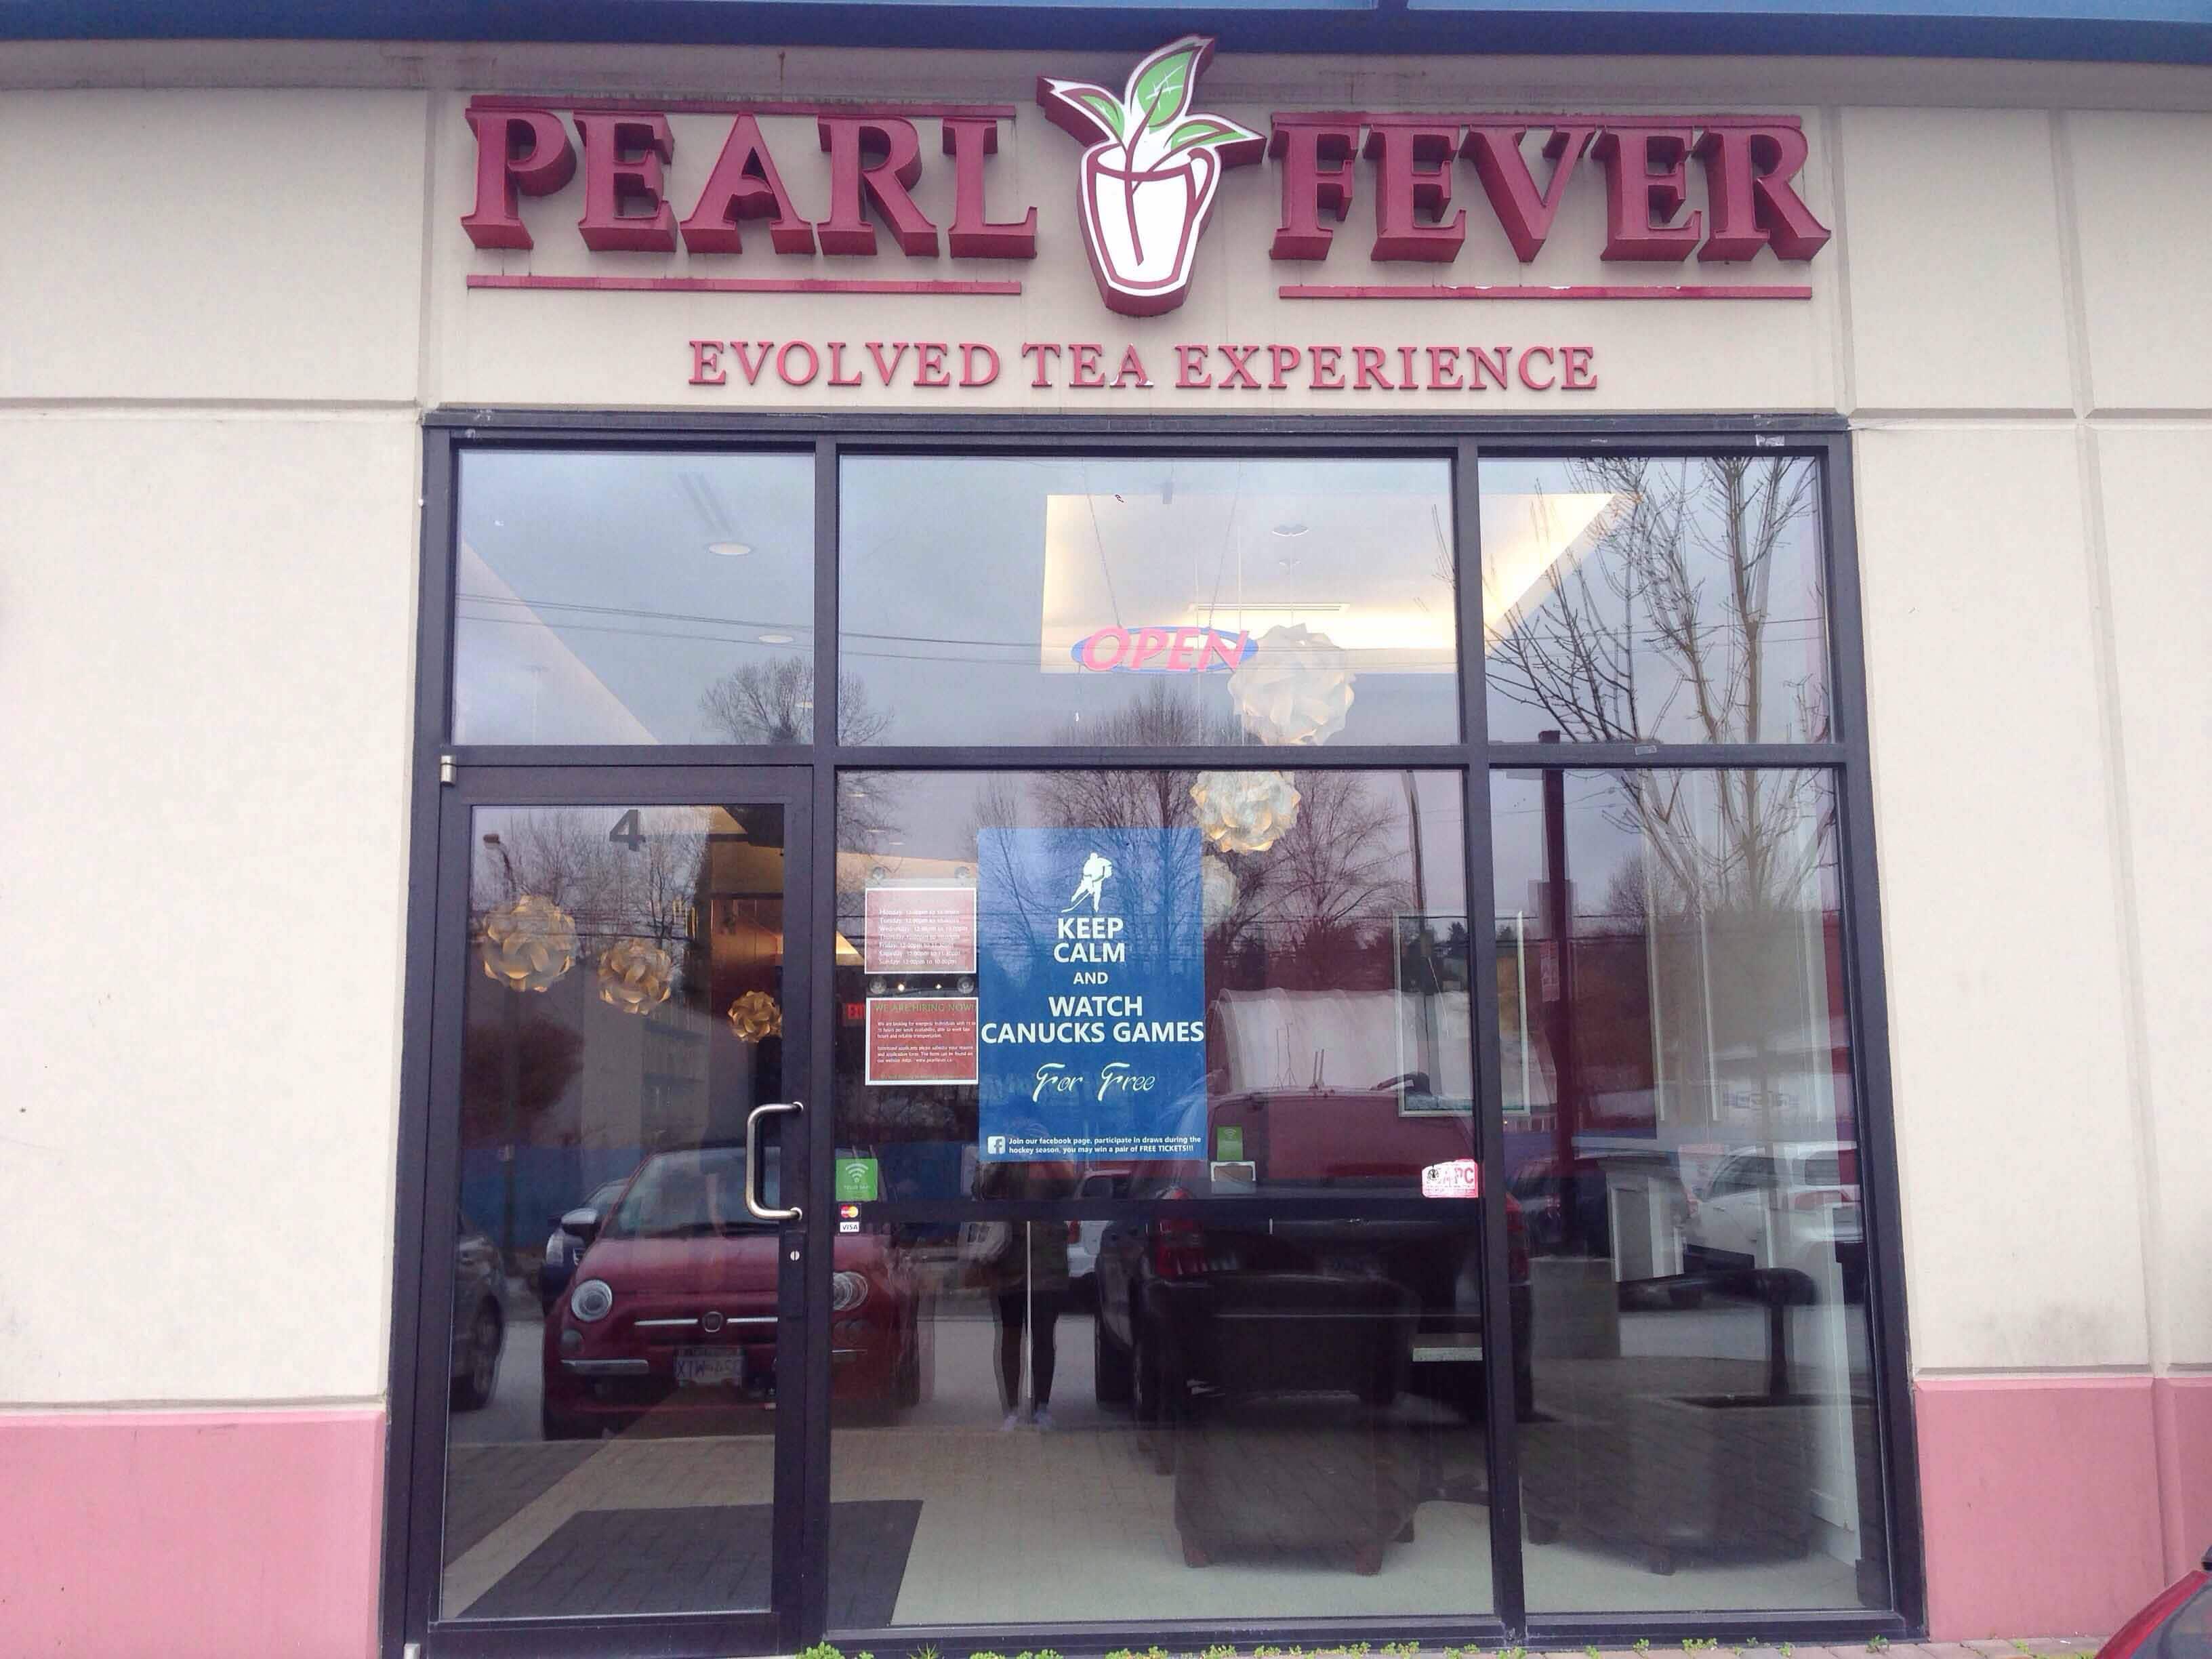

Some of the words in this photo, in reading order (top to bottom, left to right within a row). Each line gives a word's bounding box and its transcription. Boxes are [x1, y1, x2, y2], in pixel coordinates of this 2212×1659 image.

[462, 107, 1038, 258] PEARL
[1269, 121, 1831, 263] FEVER
[688, 340, 1000, 386] EVOLVED
[1022, 342, 1153, 387] TEA
[1175, 344, 1597, 390] EXPERIENCE
[1082, 625, 1250, 672] OPEN
[610, 808, 646, 851] 4
[1057, 918, 1124, 939] KEEP
[1053, 942, 1126, 963] CALM
[1073, 972, 1109, 985] AND
[875, 1003, 888, 1012] WE
[913, 1003, 944, 1012] HIRING
[1048, 996, 1143, 1017] WATCH
[981, 1022, 1105, 1044] CANUCKS
[1113, 1021, 1204, 1042] GAMES
[1032, 1063, 1084, 1102] For
[1097, 1063, 1155, 1101] Free
[1008, 1146, 1033, 1155] hockey
[1063, 1147, 1077, 1155] you
[1078, 1146, 1093, 1155] may
[1114, 1145, 1128, 1154] pair
[1158, 1144, 1193, 1152] TICKETS!!!
[1073, 1138, 1093, 1146] page,
[1094, 1136, 1132, 1145] participate
[1164, 1136, 1188, 1145] during
